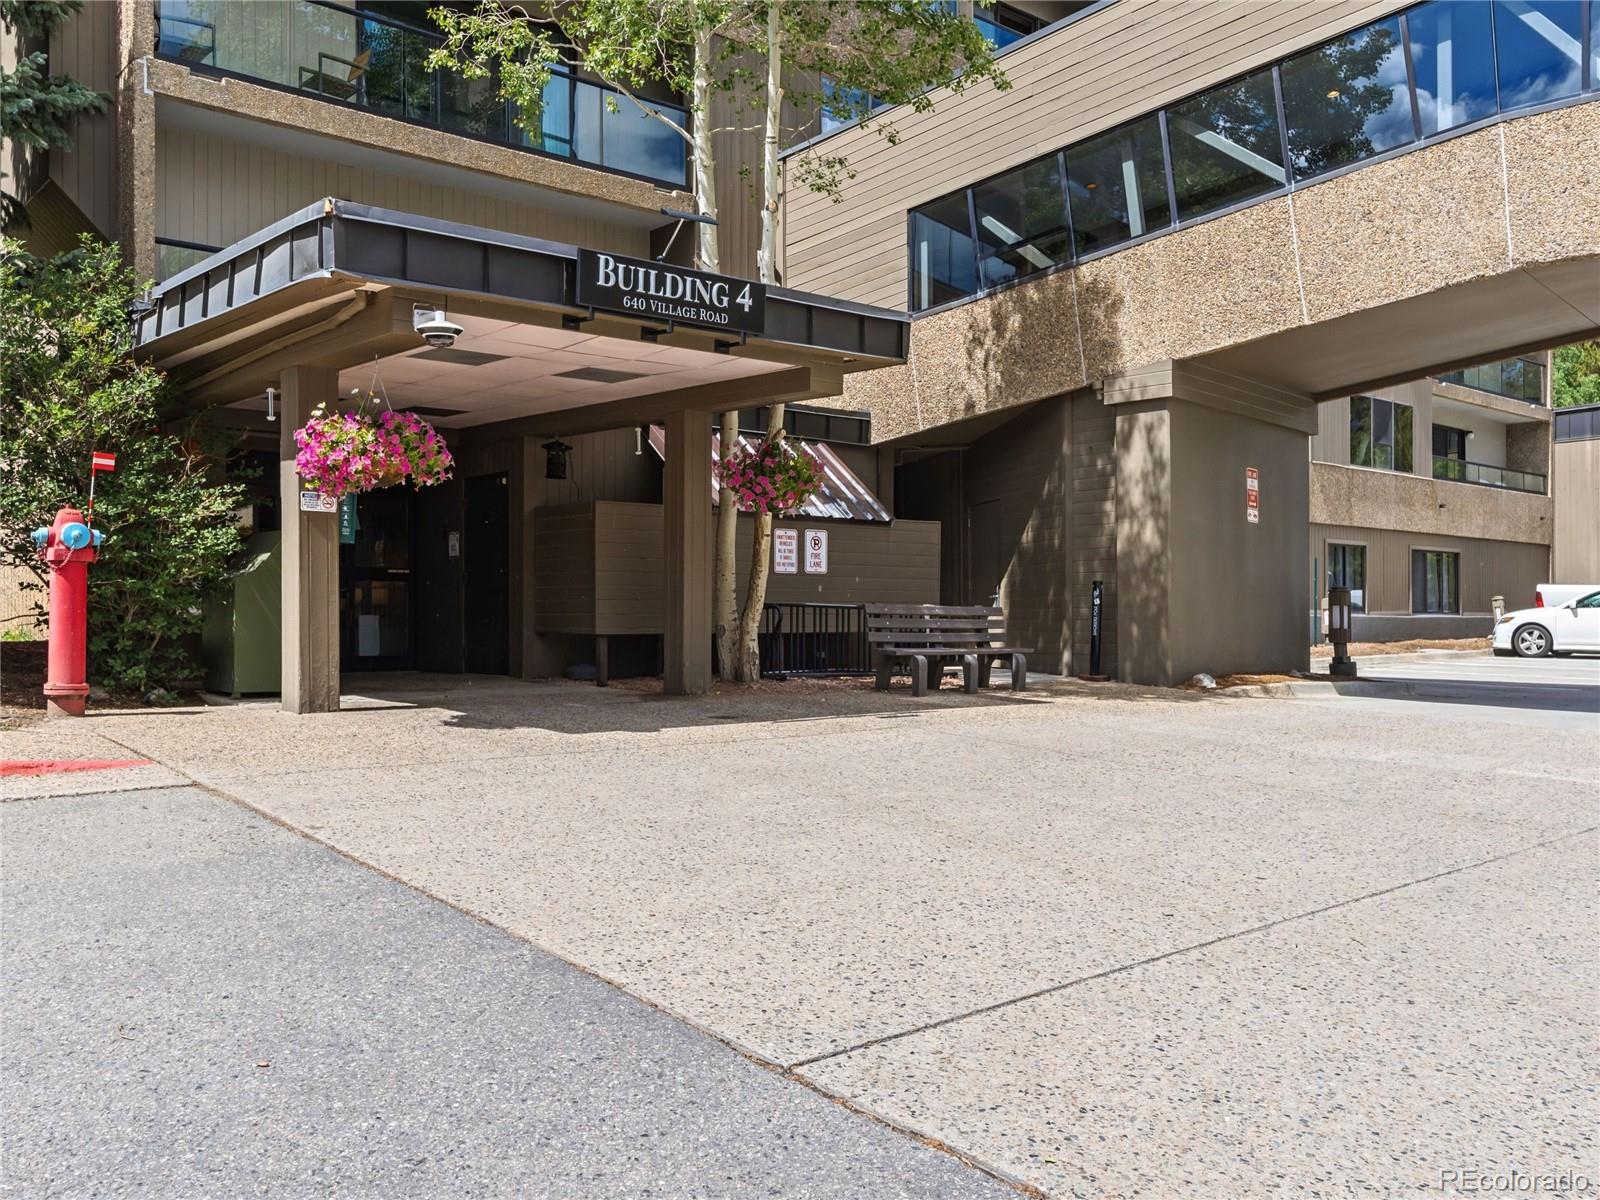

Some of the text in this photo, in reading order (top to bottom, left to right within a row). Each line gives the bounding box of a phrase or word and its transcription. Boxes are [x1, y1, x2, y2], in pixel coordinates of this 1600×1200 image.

[596, 254, 753, 313] BUILDING 4
[623, 296, 729, 325] 640 VILLAGE ROAD
[810, 552, 821, 560] FIRE
